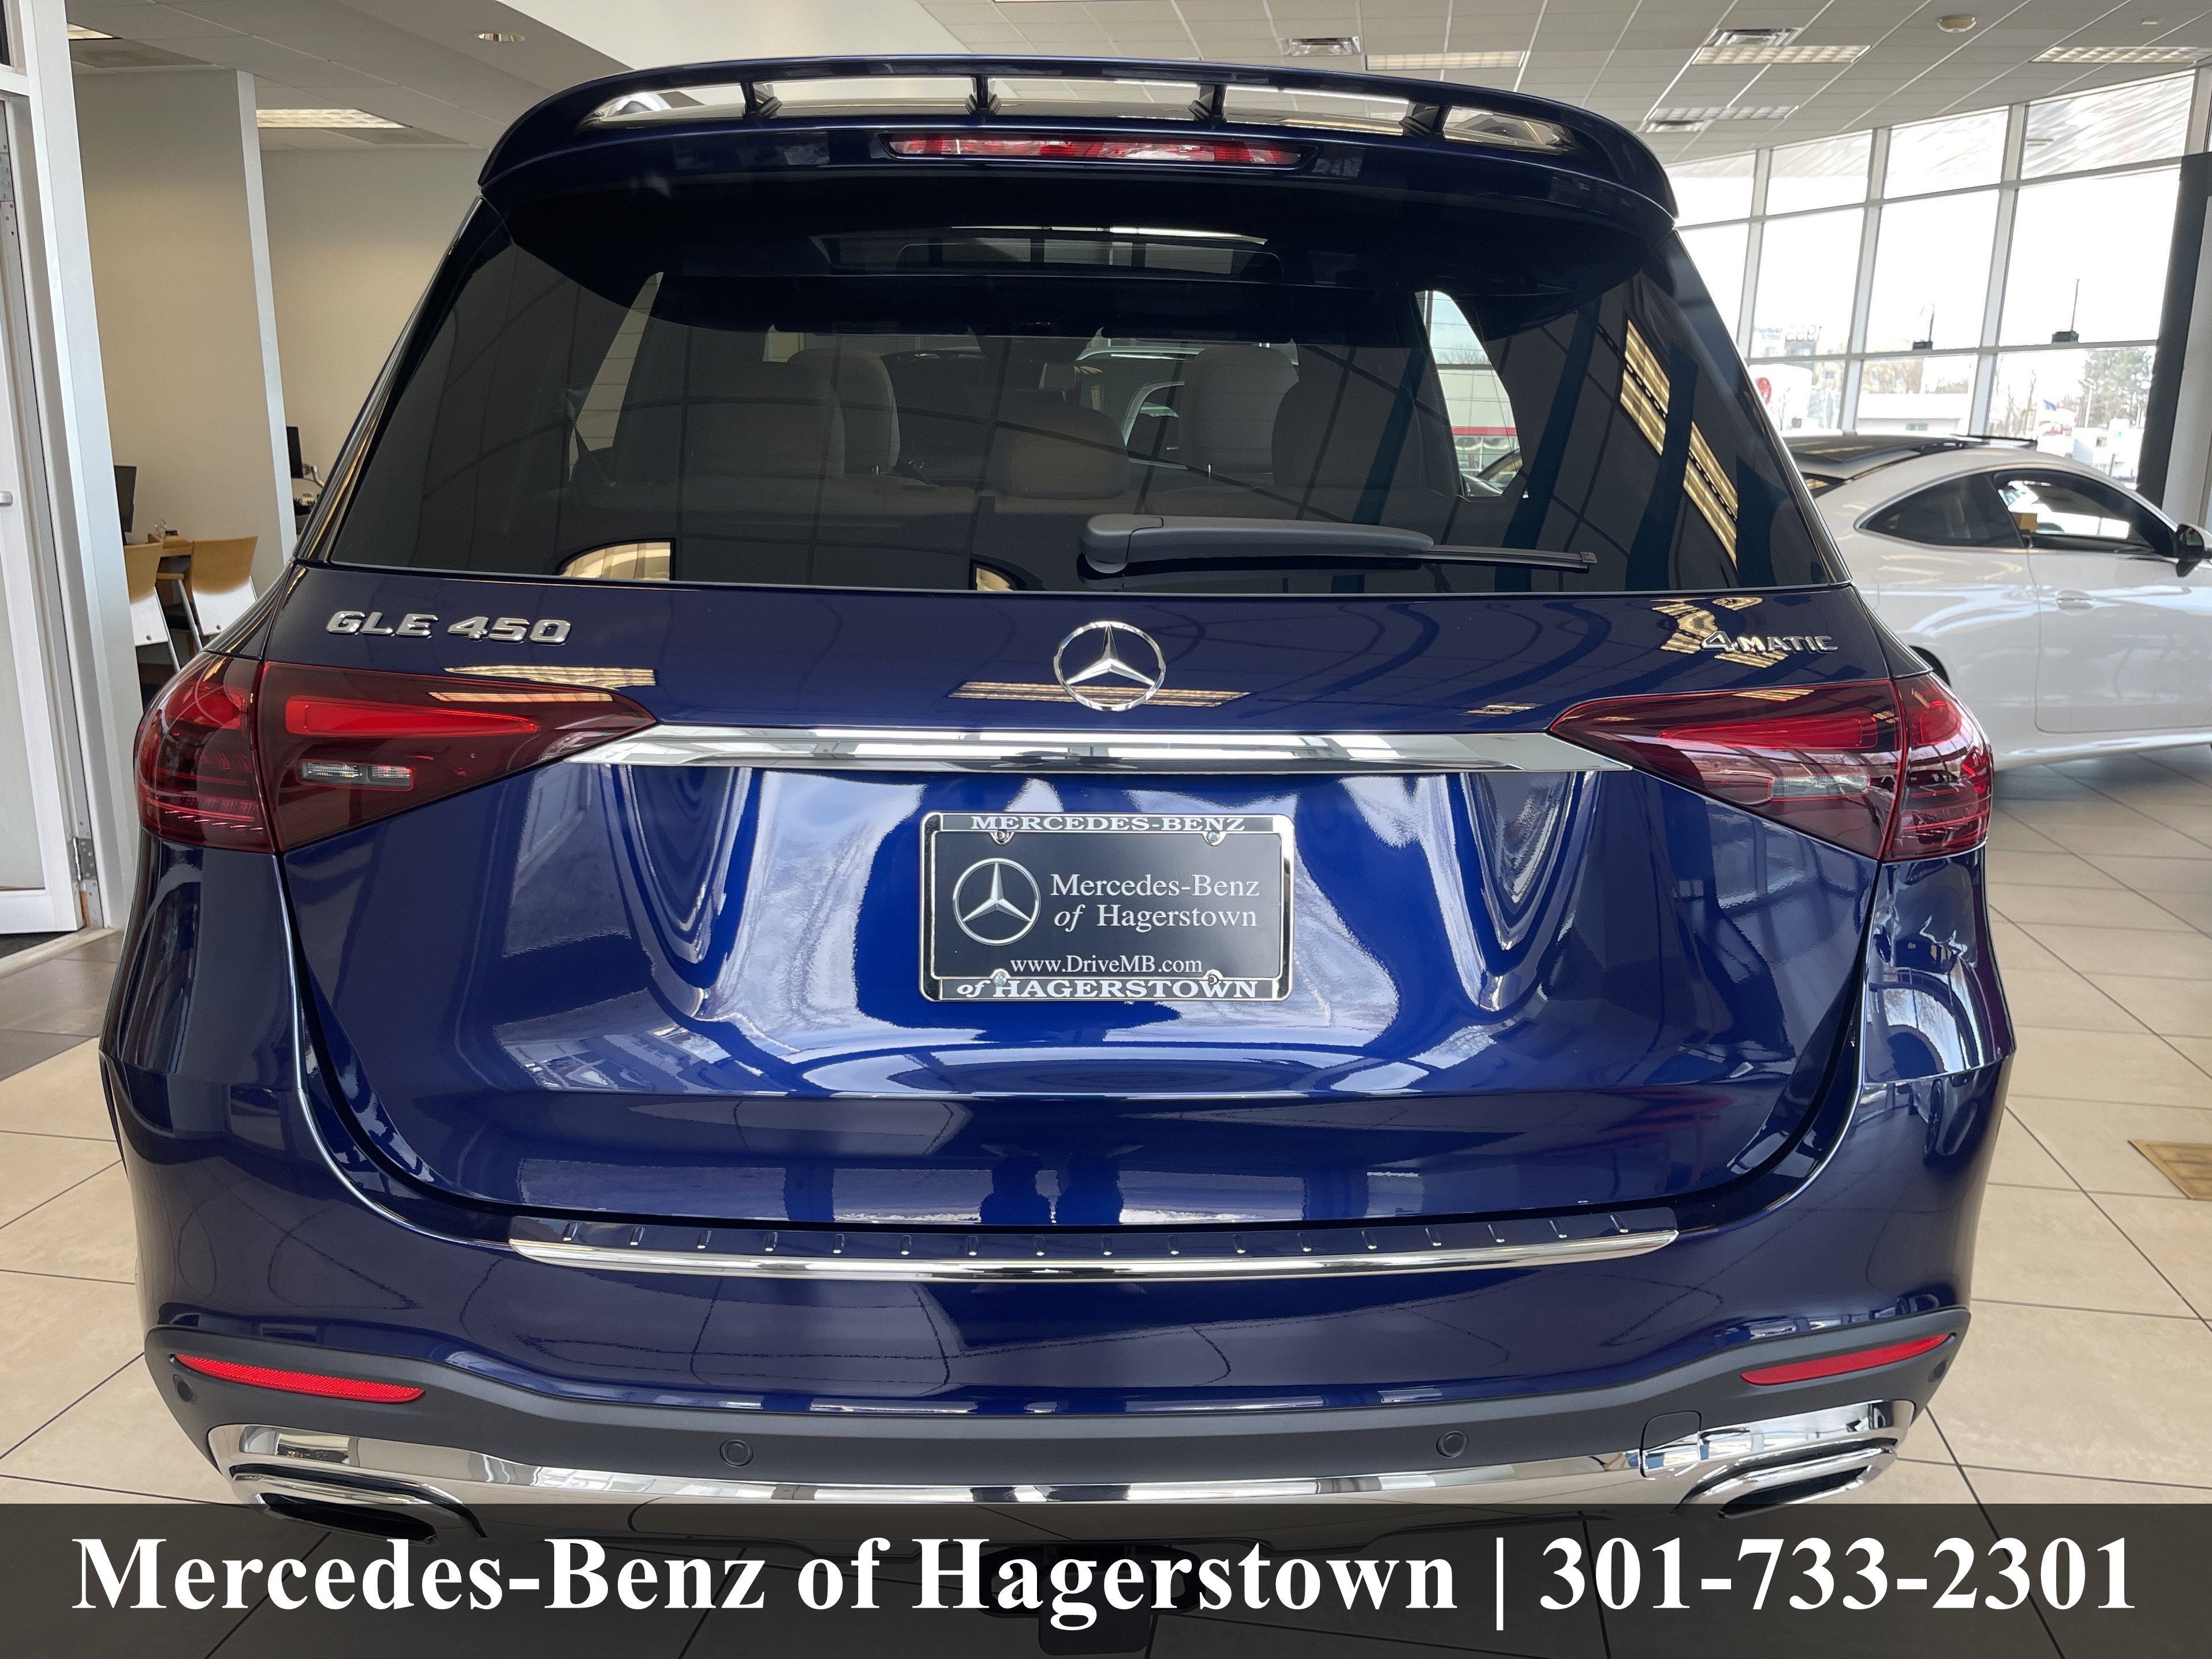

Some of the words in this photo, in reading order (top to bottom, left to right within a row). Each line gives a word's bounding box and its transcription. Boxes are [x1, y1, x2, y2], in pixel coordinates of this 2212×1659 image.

[326, 610, 439, 637] GLE
[447, 616, 572, 643] 450
[1701, 631, 1838, 653] 4MATIC
[971, 816, 1245, 832] MERCEDES-BENZ
[1050, 874, 1260, 897] Mercedes-Benz
[1054, 904, 1086, 933] of
[1096, 904, 1258, 933] Hagerstown
[1010, 955, 1204, 973] www.DriveMB.com
[957, 980, 991, 998] of
[993, 980, 1258, 998] HAGERSTOWN
